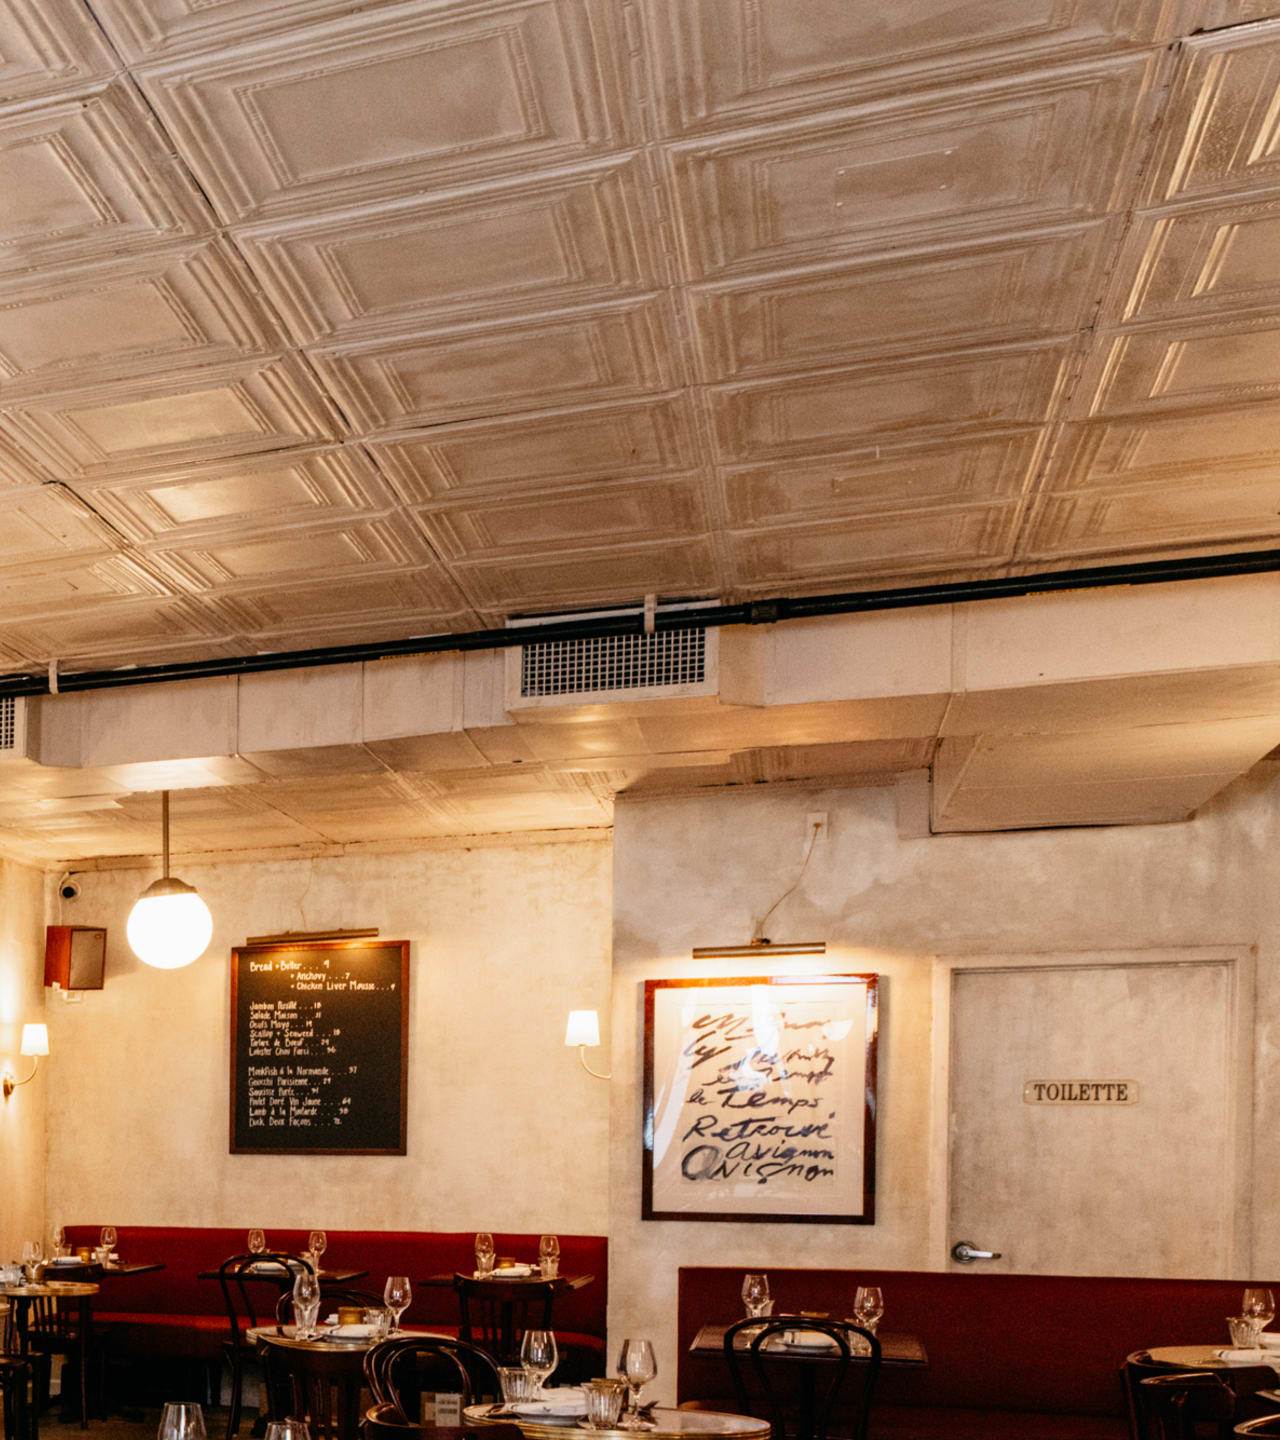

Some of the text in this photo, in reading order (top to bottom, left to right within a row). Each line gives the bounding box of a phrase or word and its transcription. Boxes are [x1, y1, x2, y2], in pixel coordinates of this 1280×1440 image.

[296, 972, 326, 982] Anchovy
[326, 982, 347, 991] Liver
[1033, 1083, 1129, 1101] TOILETTE
